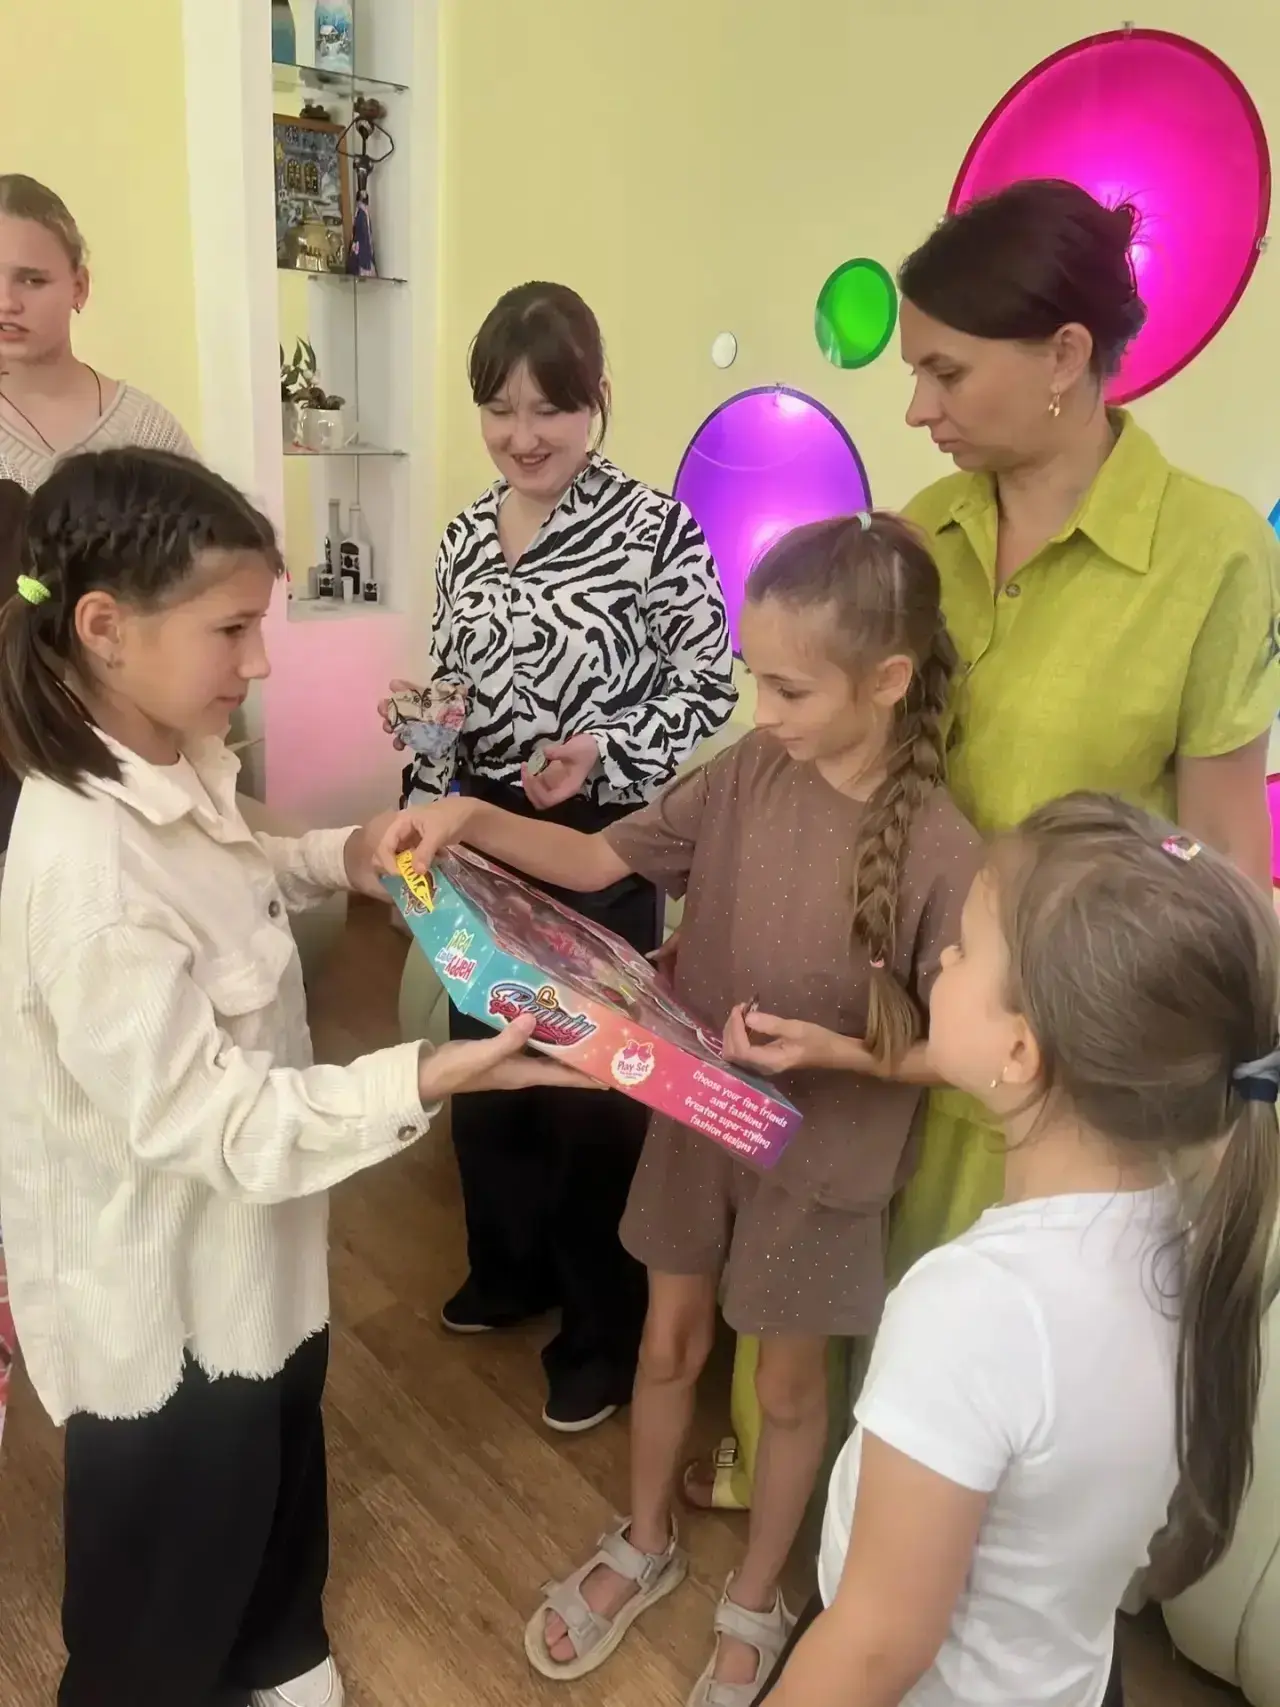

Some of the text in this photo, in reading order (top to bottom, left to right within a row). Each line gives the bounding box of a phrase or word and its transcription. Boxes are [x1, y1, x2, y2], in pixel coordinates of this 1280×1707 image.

[489, 982, 597, 1046] Beauty
[617, 1060, 650, 1073] Play Set
[692, 1069, 722, 1092] Choose
[721, 1087, 743, 1103] your
[759, 1106, 789, 1129] friends
[709, 1095, 728, 1111] and
[728, 1104, 764, 1129] fashions
[690, 1113, 723, 1137] fashion
[721, 1131, 752, 1154] designs
[717, 1114, 772, 1149] super-styling
